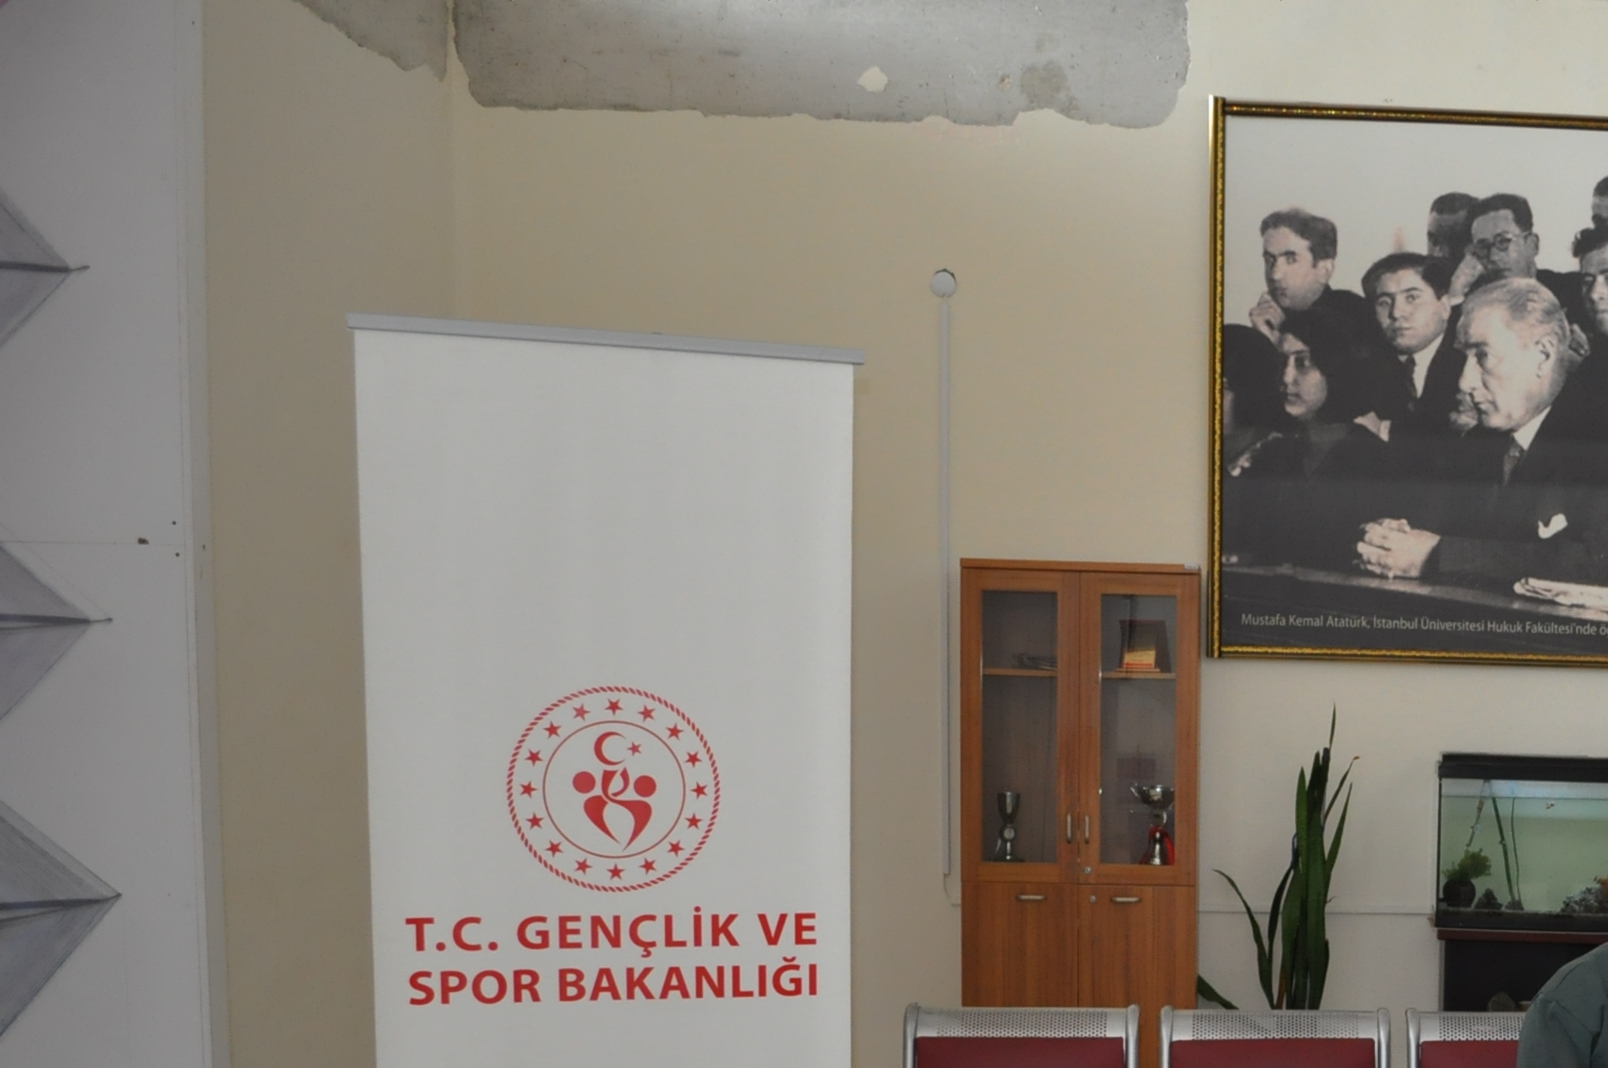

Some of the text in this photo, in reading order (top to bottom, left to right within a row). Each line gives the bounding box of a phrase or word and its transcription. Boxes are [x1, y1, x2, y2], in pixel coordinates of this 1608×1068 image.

[1241, 613, 1286, 627] Mustafa
[1288, 614, 1324, 627] Kemal
[1326, 614, 1371, 630] Atatürk,
[1373, 614, 1418, 630] İstanbul
[1420, 616, 1485, 632] Üniversitesi
[1487, 619, 1523, 633] Hukuk
[1525, 622, 1597, 635] Fakültesi'nde
[405, 905, 818, 959] T.C. GENÇLİK VE
[408, 956, 818, 1006] SPOR BAKANLIĞI
